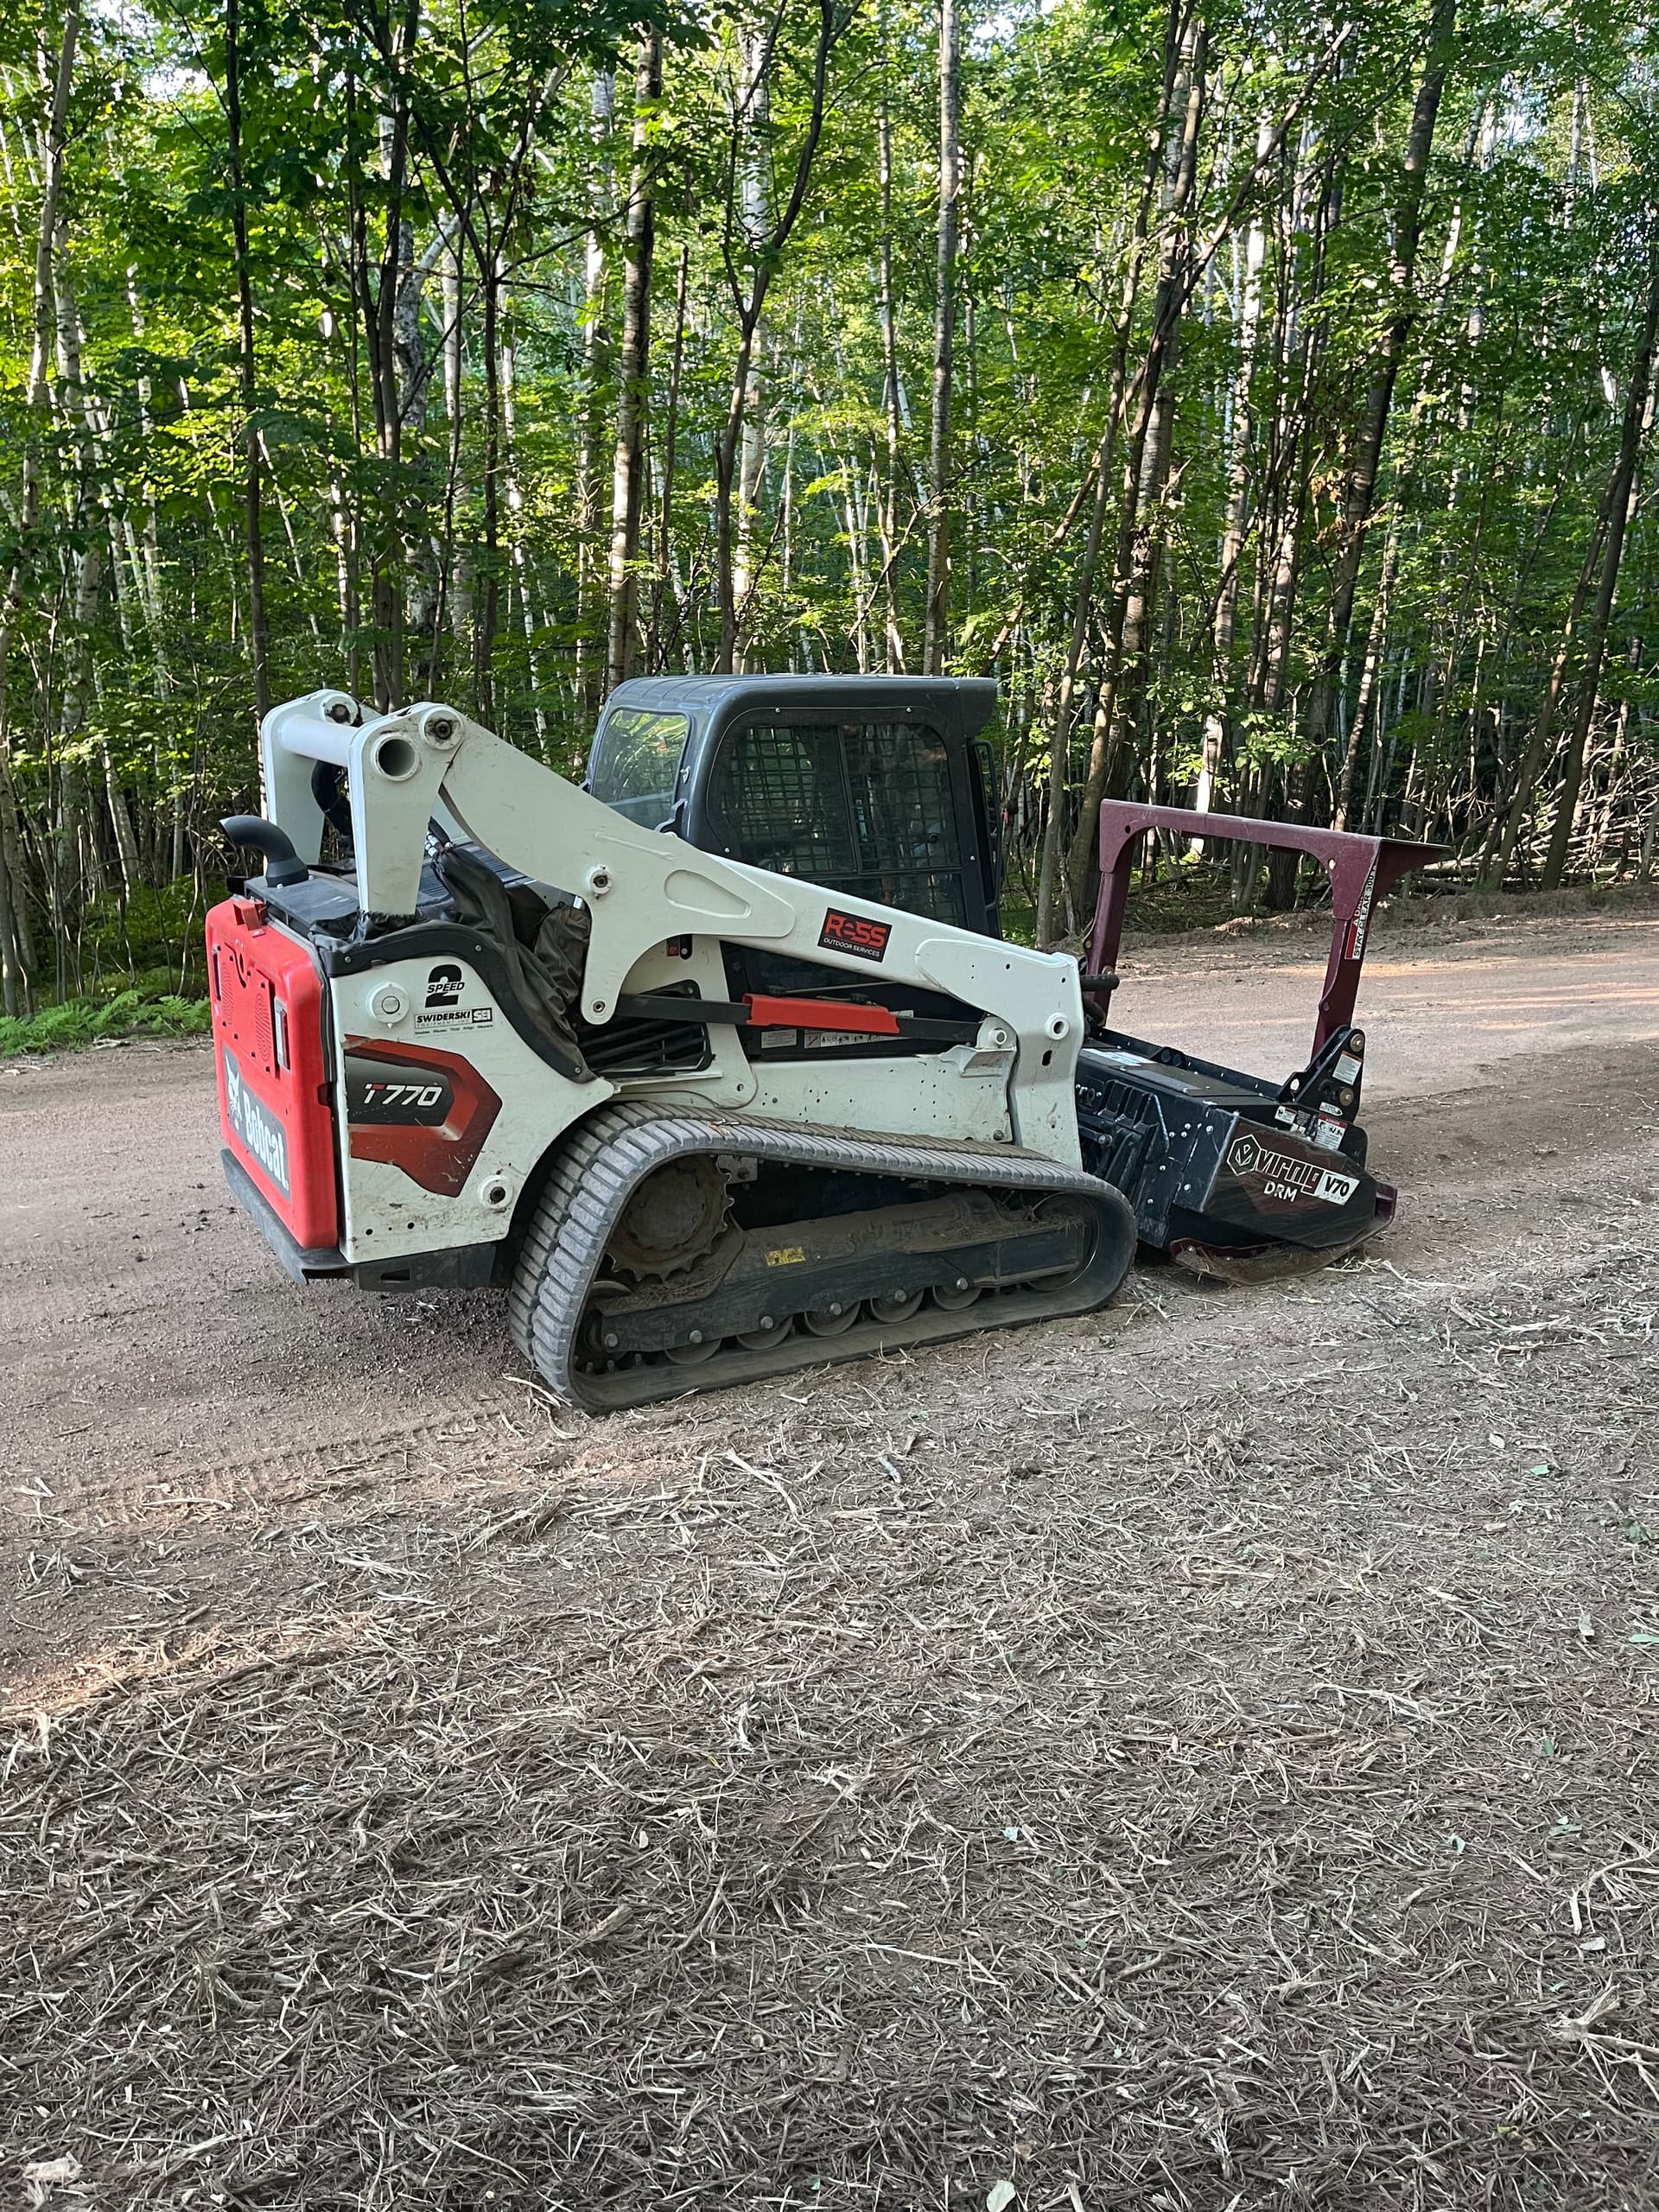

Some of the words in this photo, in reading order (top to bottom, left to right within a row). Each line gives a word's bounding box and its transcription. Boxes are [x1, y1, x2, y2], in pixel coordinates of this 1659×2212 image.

[823, 938, 852, 950] OUTDOOR
[853, 945, 880, 957] SERVICES
[1354, 932, 1363, 956] STAY
[424, 964, 462, 1008] 2
[427, 982, 465, 994] SPEED
[416, 1011, 471, 1024] SWIDERSKI
[473, 1009, 491, 1021] SEI
[364, 1083, 443, 1106] T770
[243, 1090, 287, 1190] Bobcat
[1263, 1180, 1298, 1203] DRM
[1325, 1176, 1350, 1198] V70
